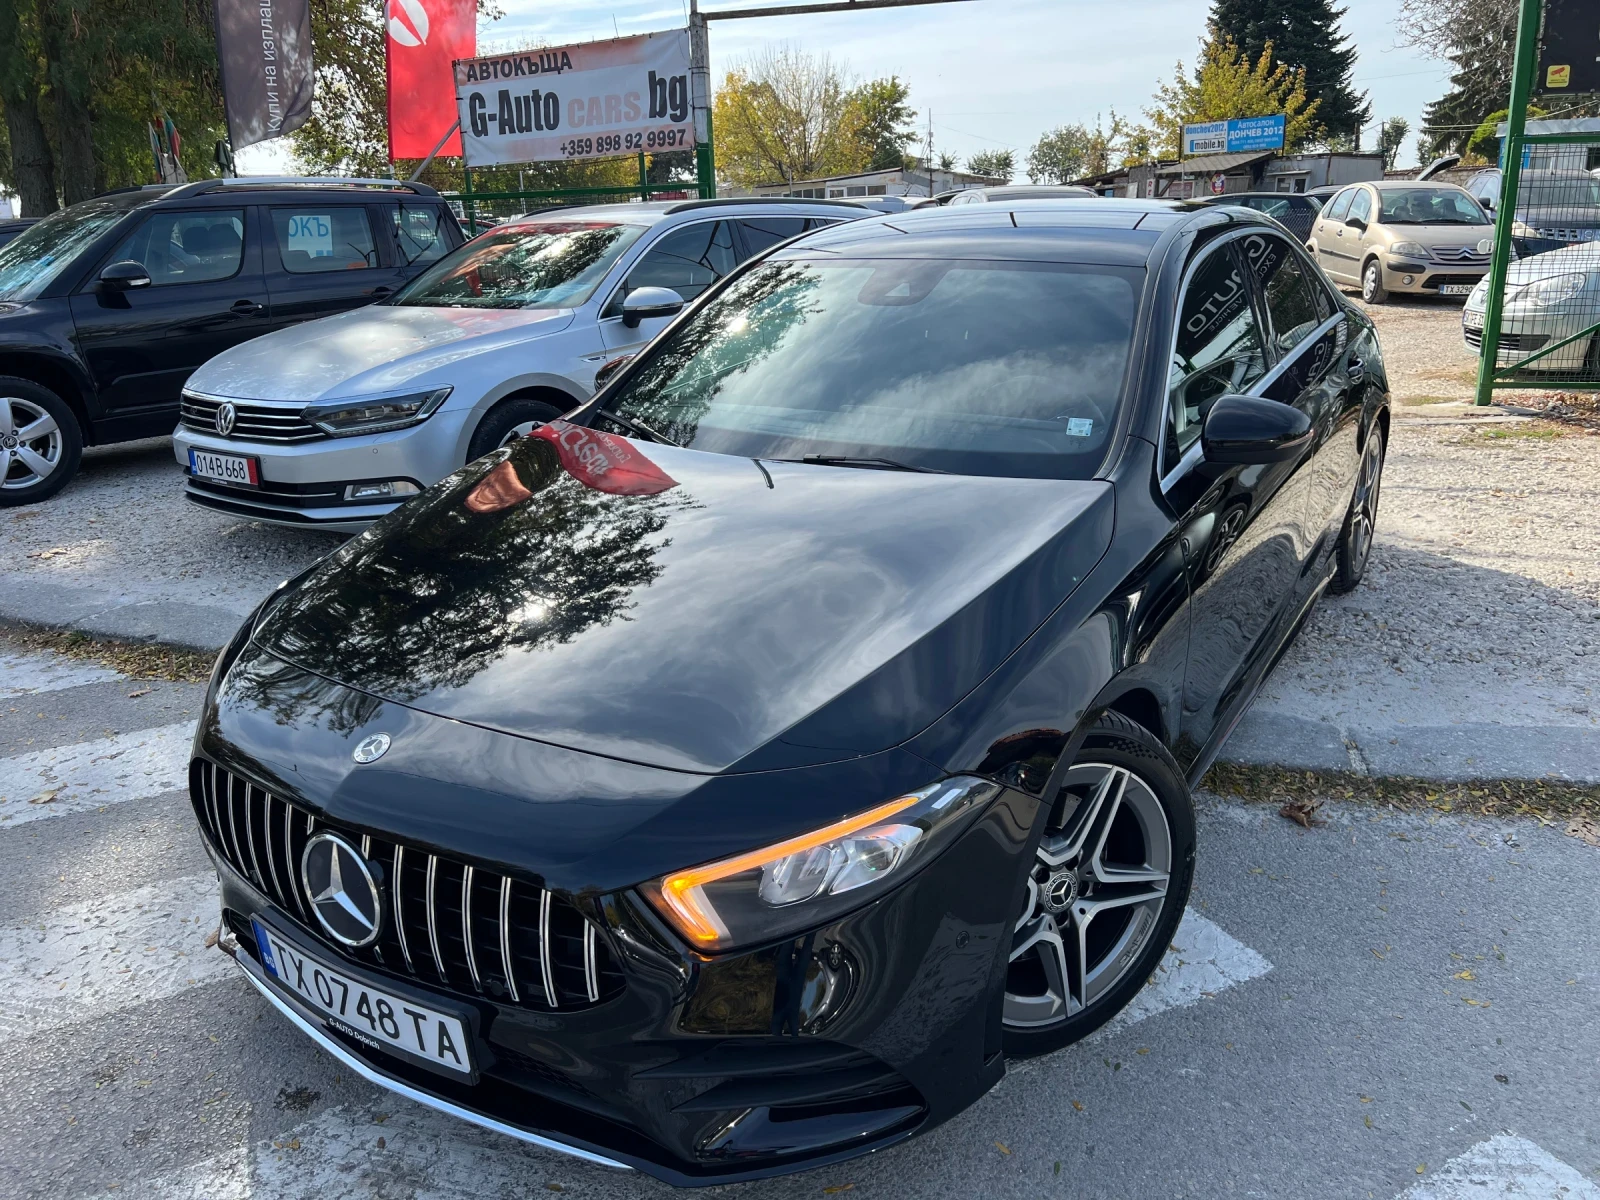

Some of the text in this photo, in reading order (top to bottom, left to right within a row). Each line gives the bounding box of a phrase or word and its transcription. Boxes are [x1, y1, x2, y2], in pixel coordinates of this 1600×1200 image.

[265, 65, 278, 87] на
[467, 51, 573, 82] АВТОКЪЩА
[267, 91, 282, 132] Купи
[469, 89, 560, 138] G-Auto
[1237, 119, 1275, 129] Автосалон
[560, 128, 687, 156] +359 898 92 9997
[1194, 139, 1225, 150] mobile.bg
[1229, 127, 1262, 140] ДОНЧЕВ
[1263, 126, 1283, 136] 2012
